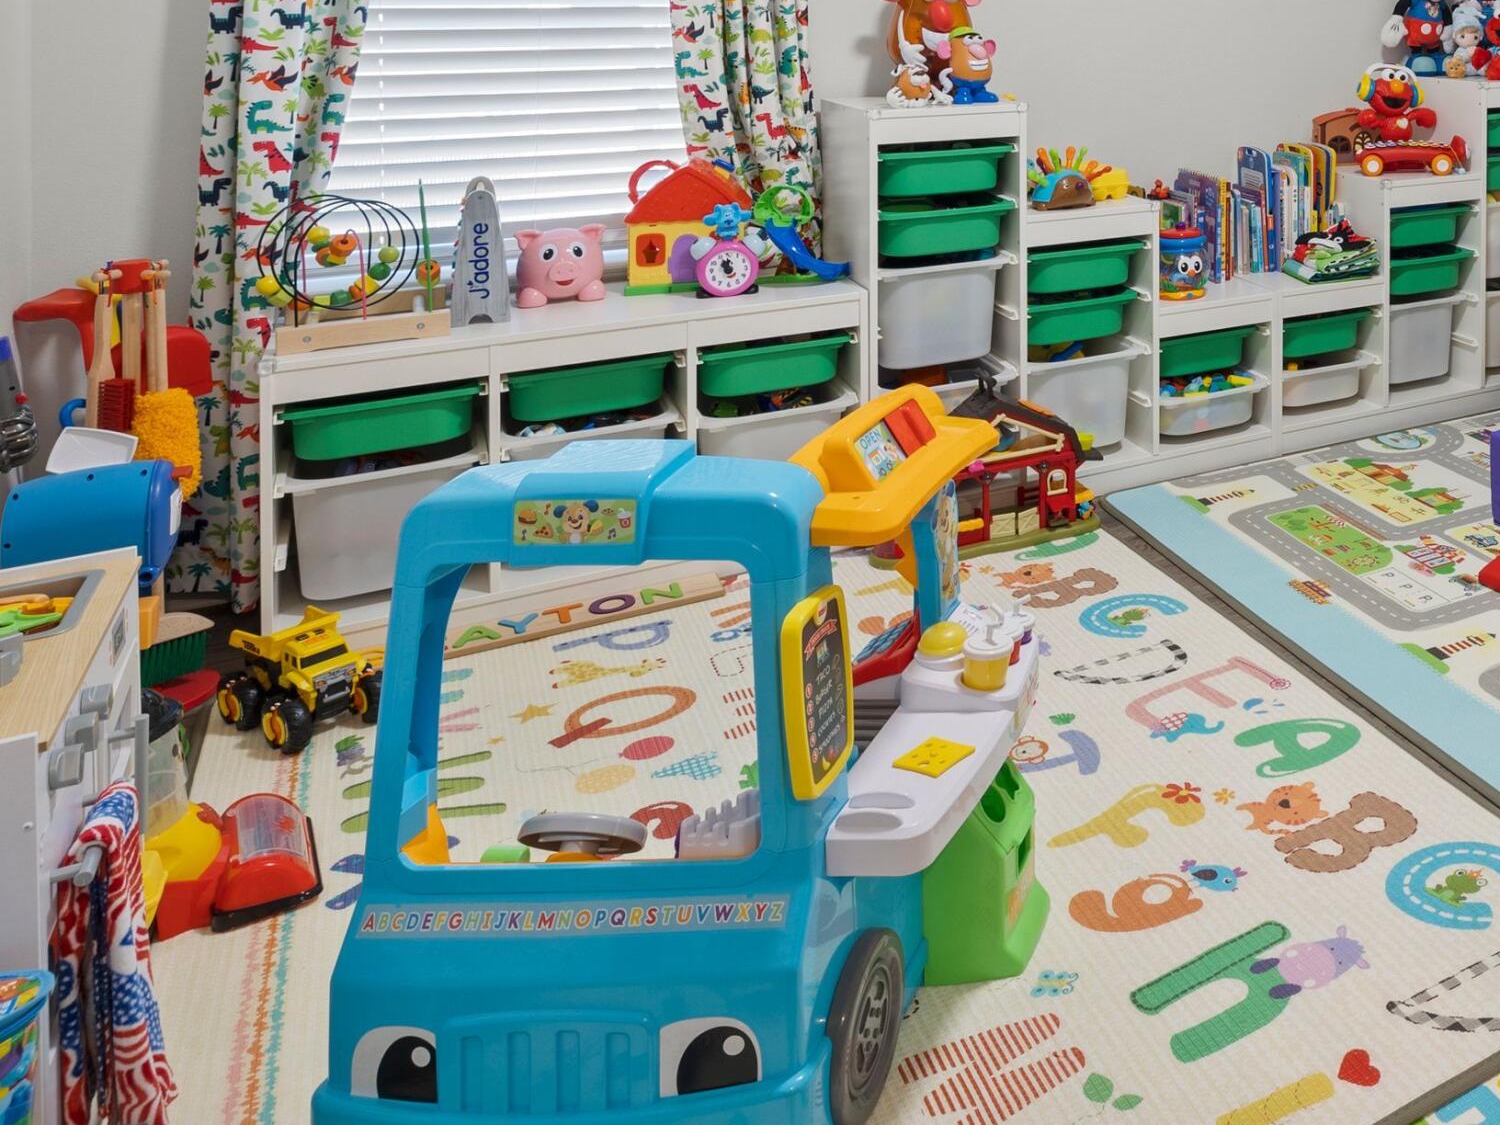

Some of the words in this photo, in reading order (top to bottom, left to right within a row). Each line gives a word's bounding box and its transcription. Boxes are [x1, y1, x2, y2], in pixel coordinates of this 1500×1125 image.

[860, 428, 880, 450] OPEN
[444, 582, 684, 649] AYTON
[1079, 593, 1188, 638] C
[1233, 718, 1361, 779] A
[1275, 792, 1418, 873] B
